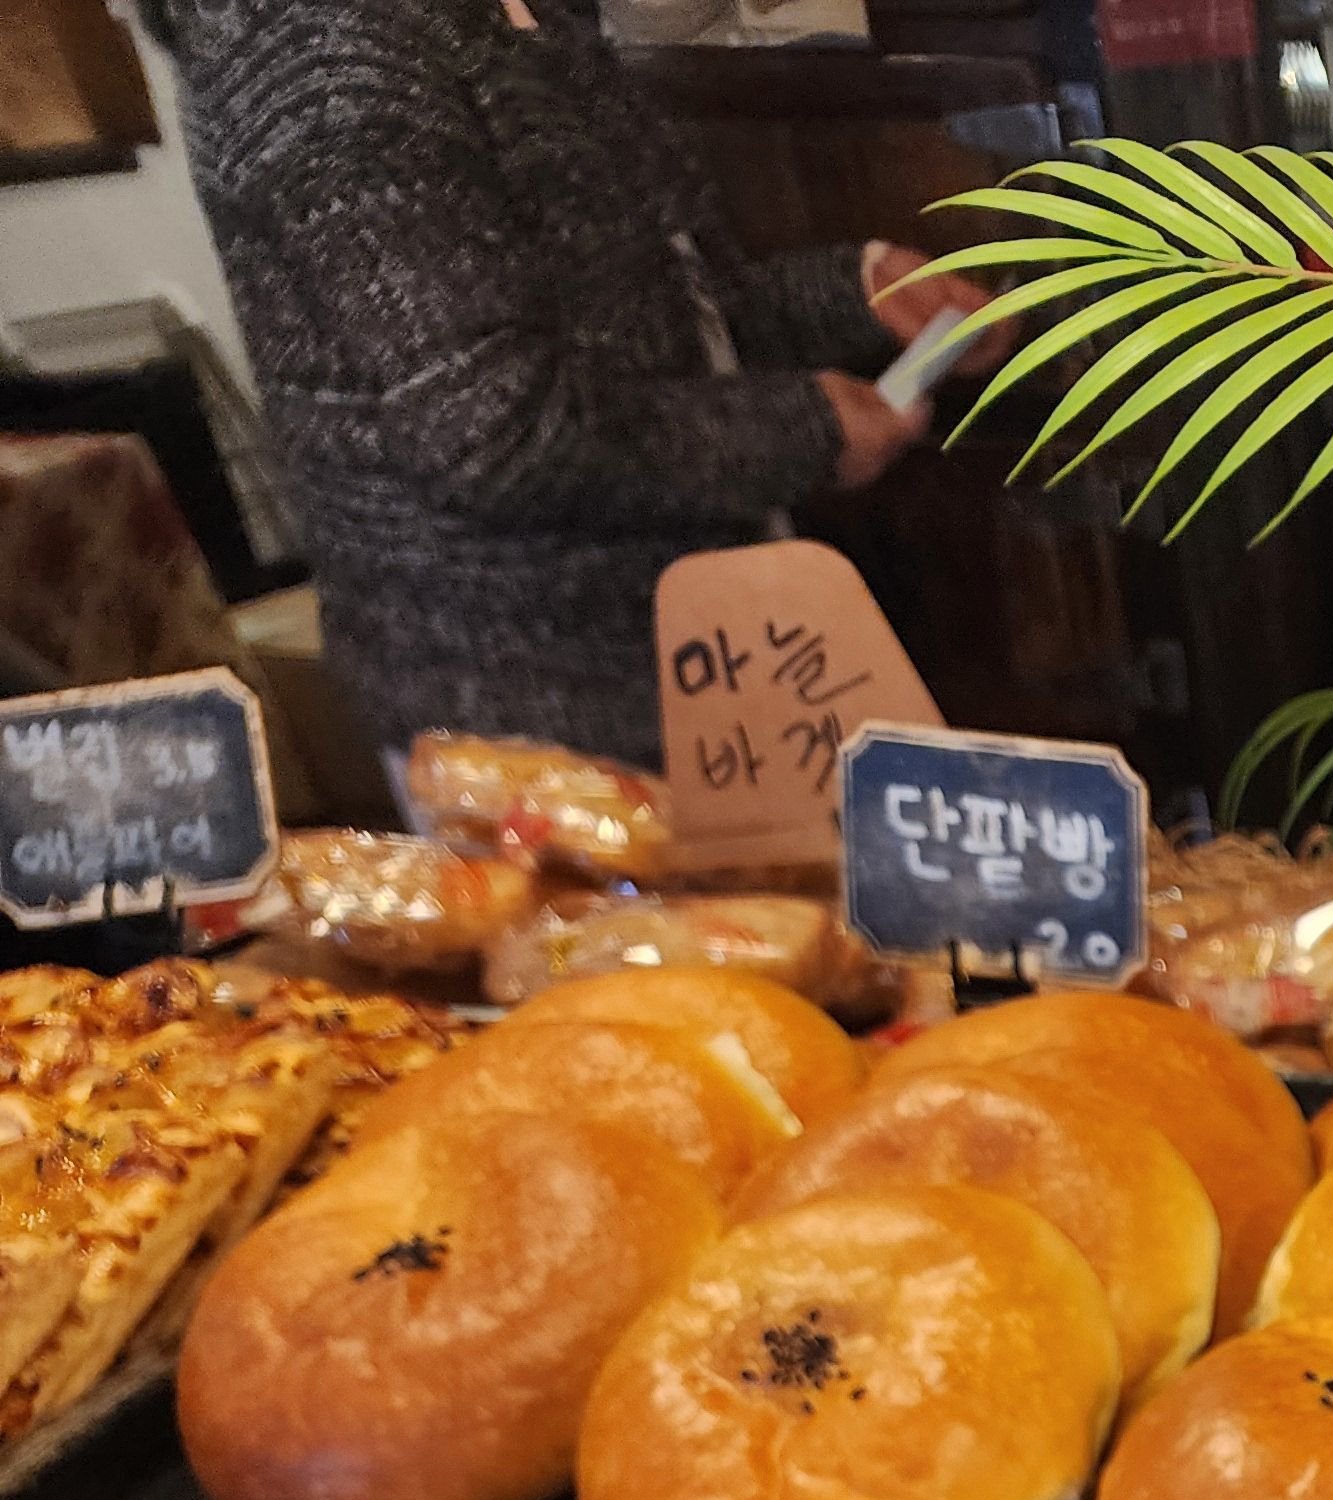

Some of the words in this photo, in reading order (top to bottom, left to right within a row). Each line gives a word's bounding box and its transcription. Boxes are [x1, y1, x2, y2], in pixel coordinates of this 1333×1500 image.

[673, 619, 873, 706] 마늘
[695, 711, 843, 835] 바게
[885, 783, 1116, 901] 단팥빵
